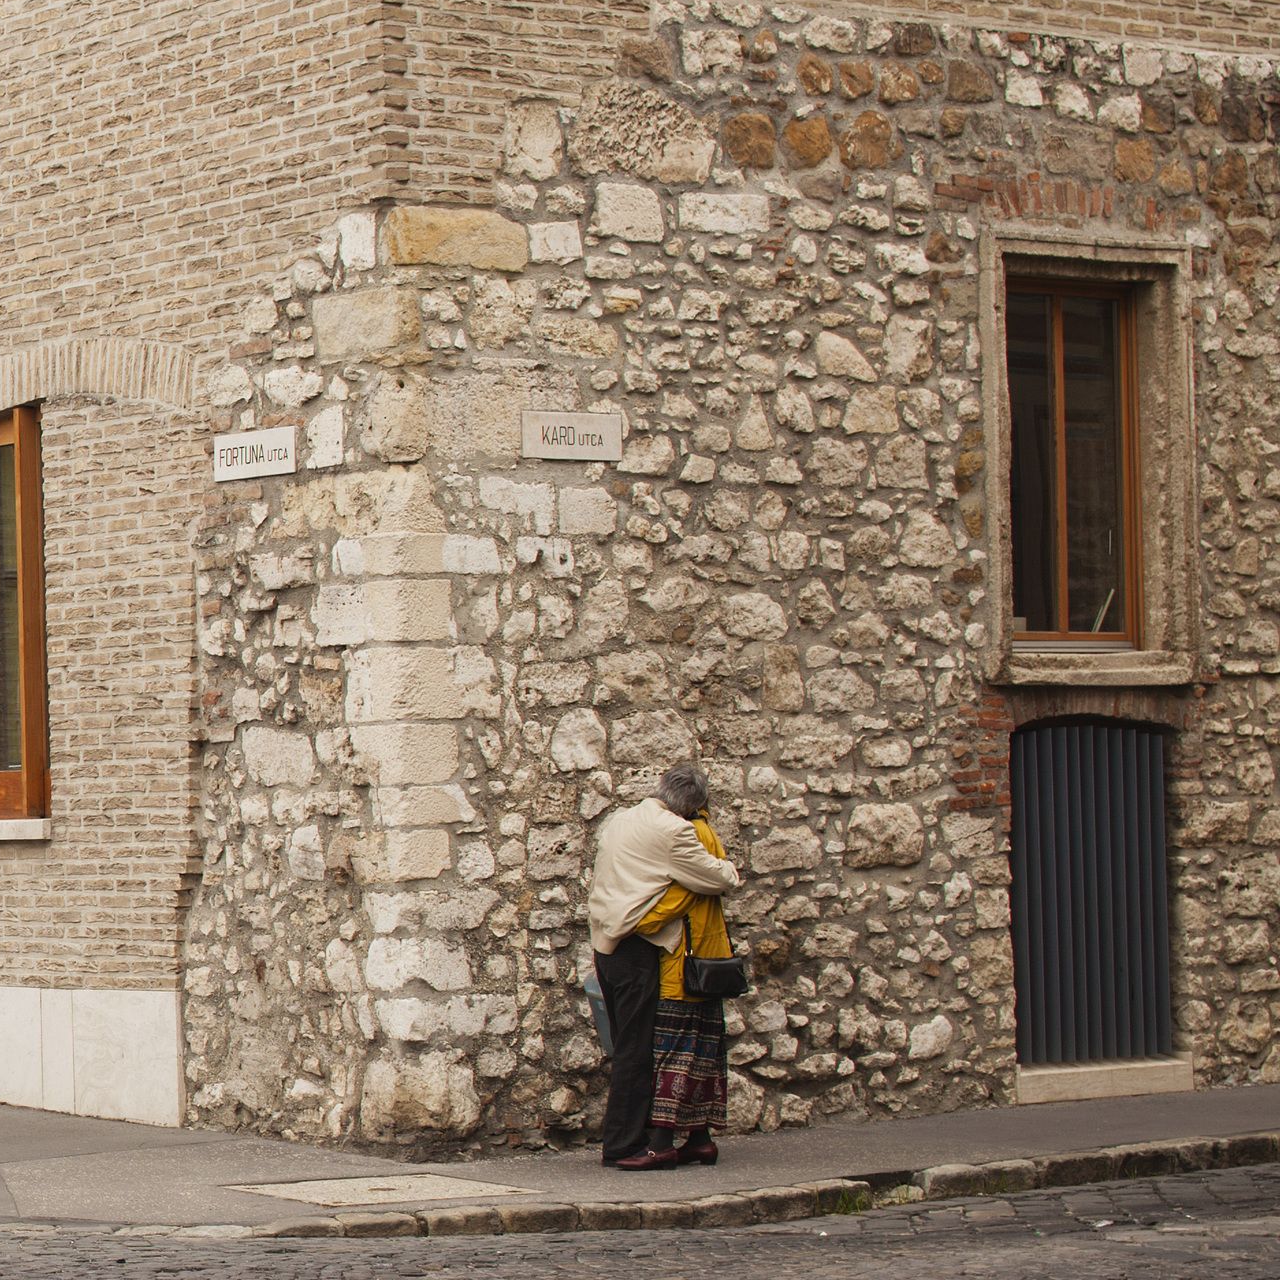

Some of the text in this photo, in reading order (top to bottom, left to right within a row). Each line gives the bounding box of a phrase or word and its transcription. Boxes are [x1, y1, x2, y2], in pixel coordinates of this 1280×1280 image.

[541, 425, 604, 447] KARD UTCA
[219, 443, 289, 468] FORTUNA UTCA
